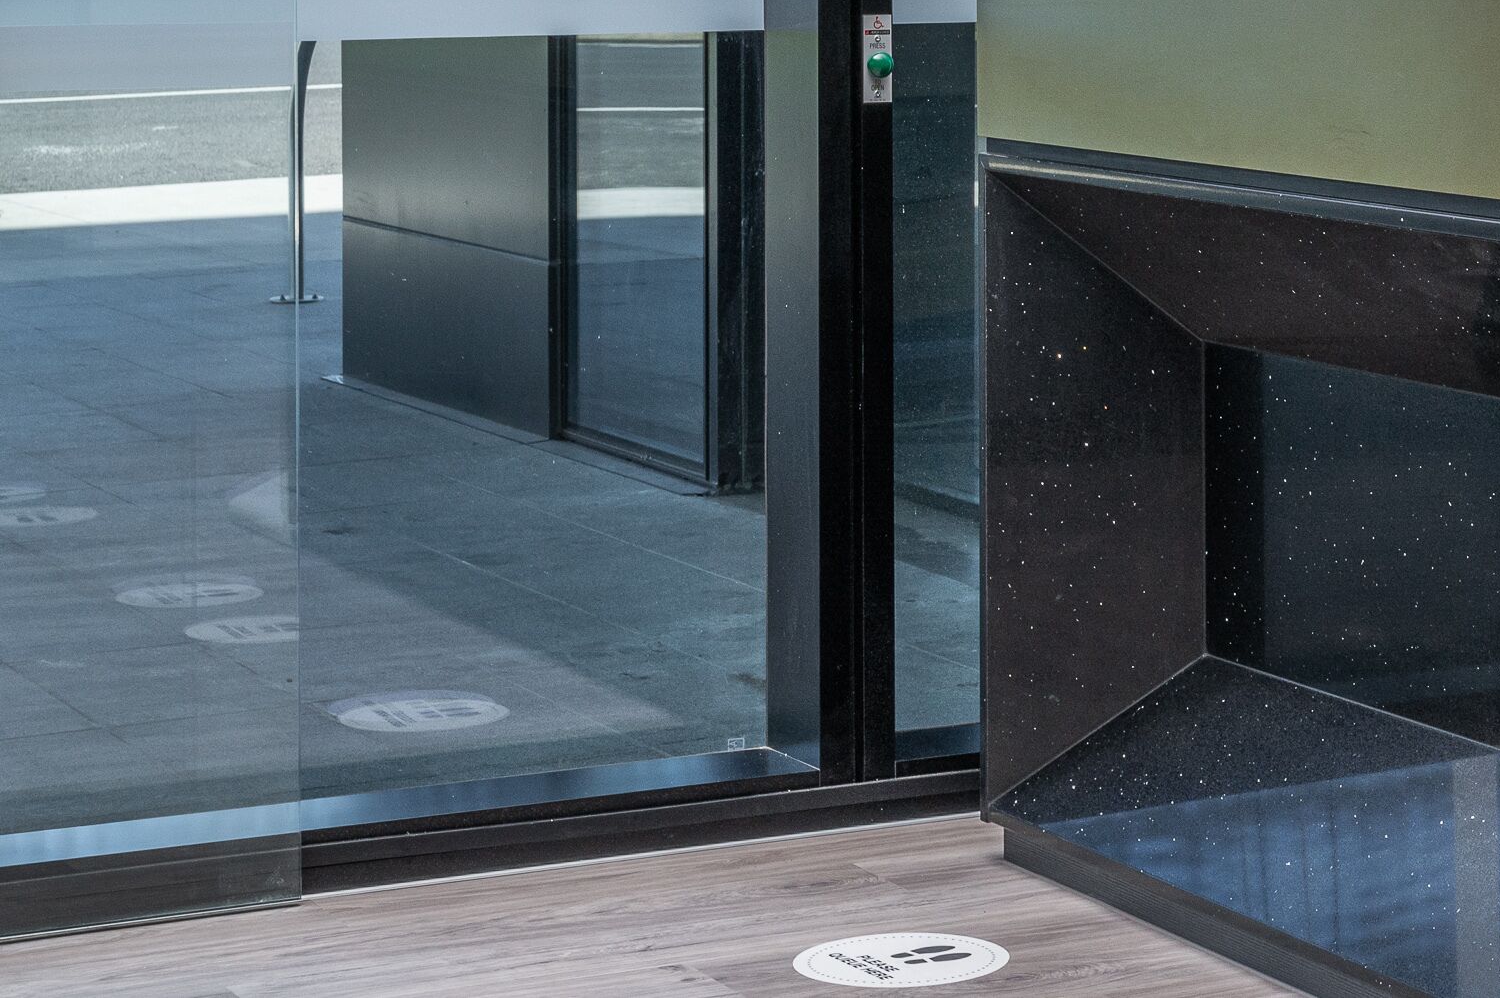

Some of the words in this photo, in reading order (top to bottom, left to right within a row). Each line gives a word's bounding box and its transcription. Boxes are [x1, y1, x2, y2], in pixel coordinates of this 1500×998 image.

[869, 42, 886, 50] PRESS
[828, 952, 867, 969] QUEUE
[860, 967, 894, 980] HERE
[856, 954, 900, 972] PLEASE
